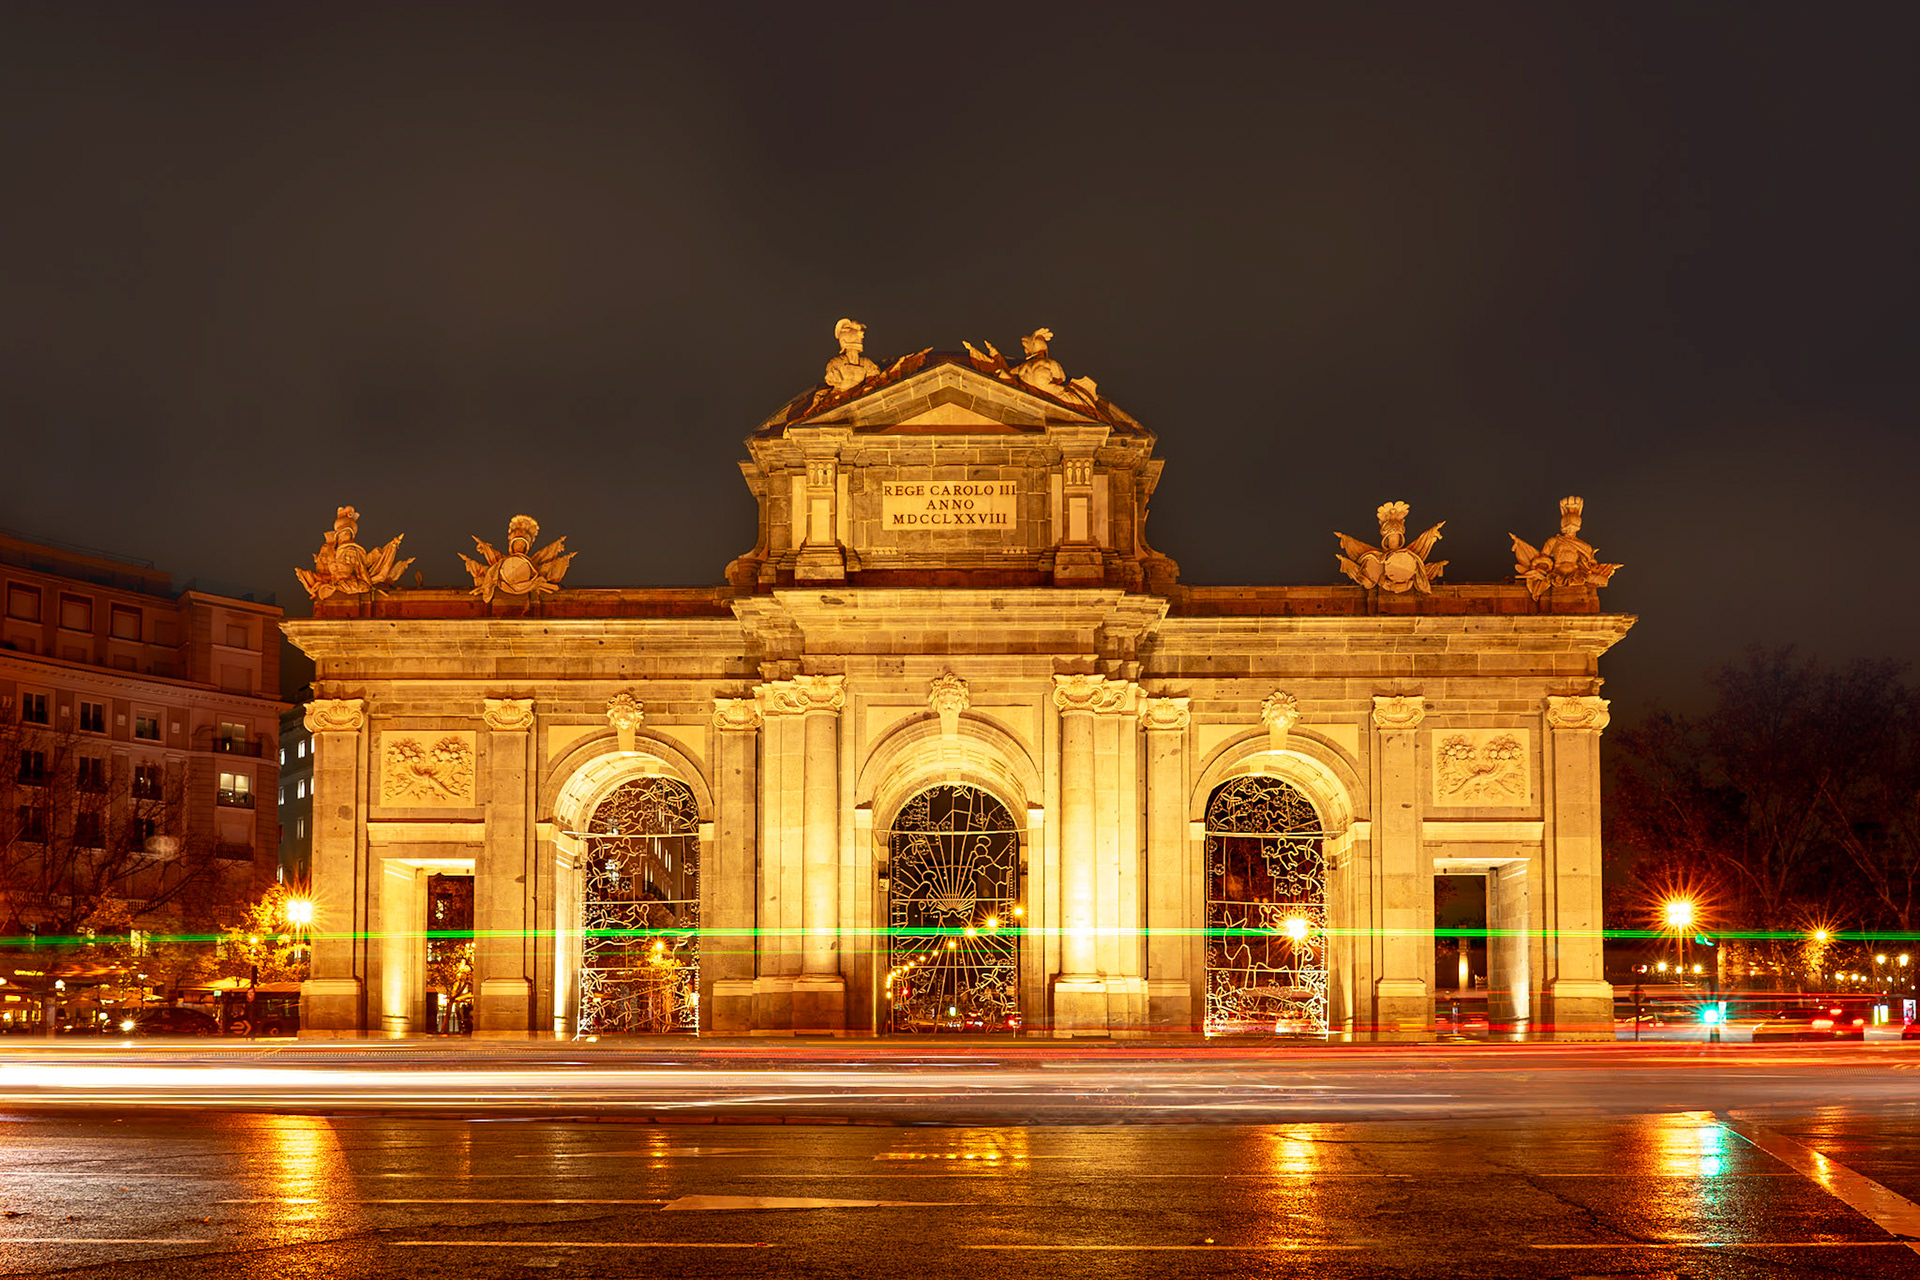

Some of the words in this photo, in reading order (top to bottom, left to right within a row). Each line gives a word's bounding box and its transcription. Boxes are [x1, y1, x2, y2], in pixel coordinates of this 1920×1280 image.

[884, 485, 925, 496] REGE
[930, 485, 994, 496] CAROLO
[999, 485, 1017, 496] III
[926, 499, 974, 510] ANNO
[892, 513, 1008, 525] MDCCLXXVIII
